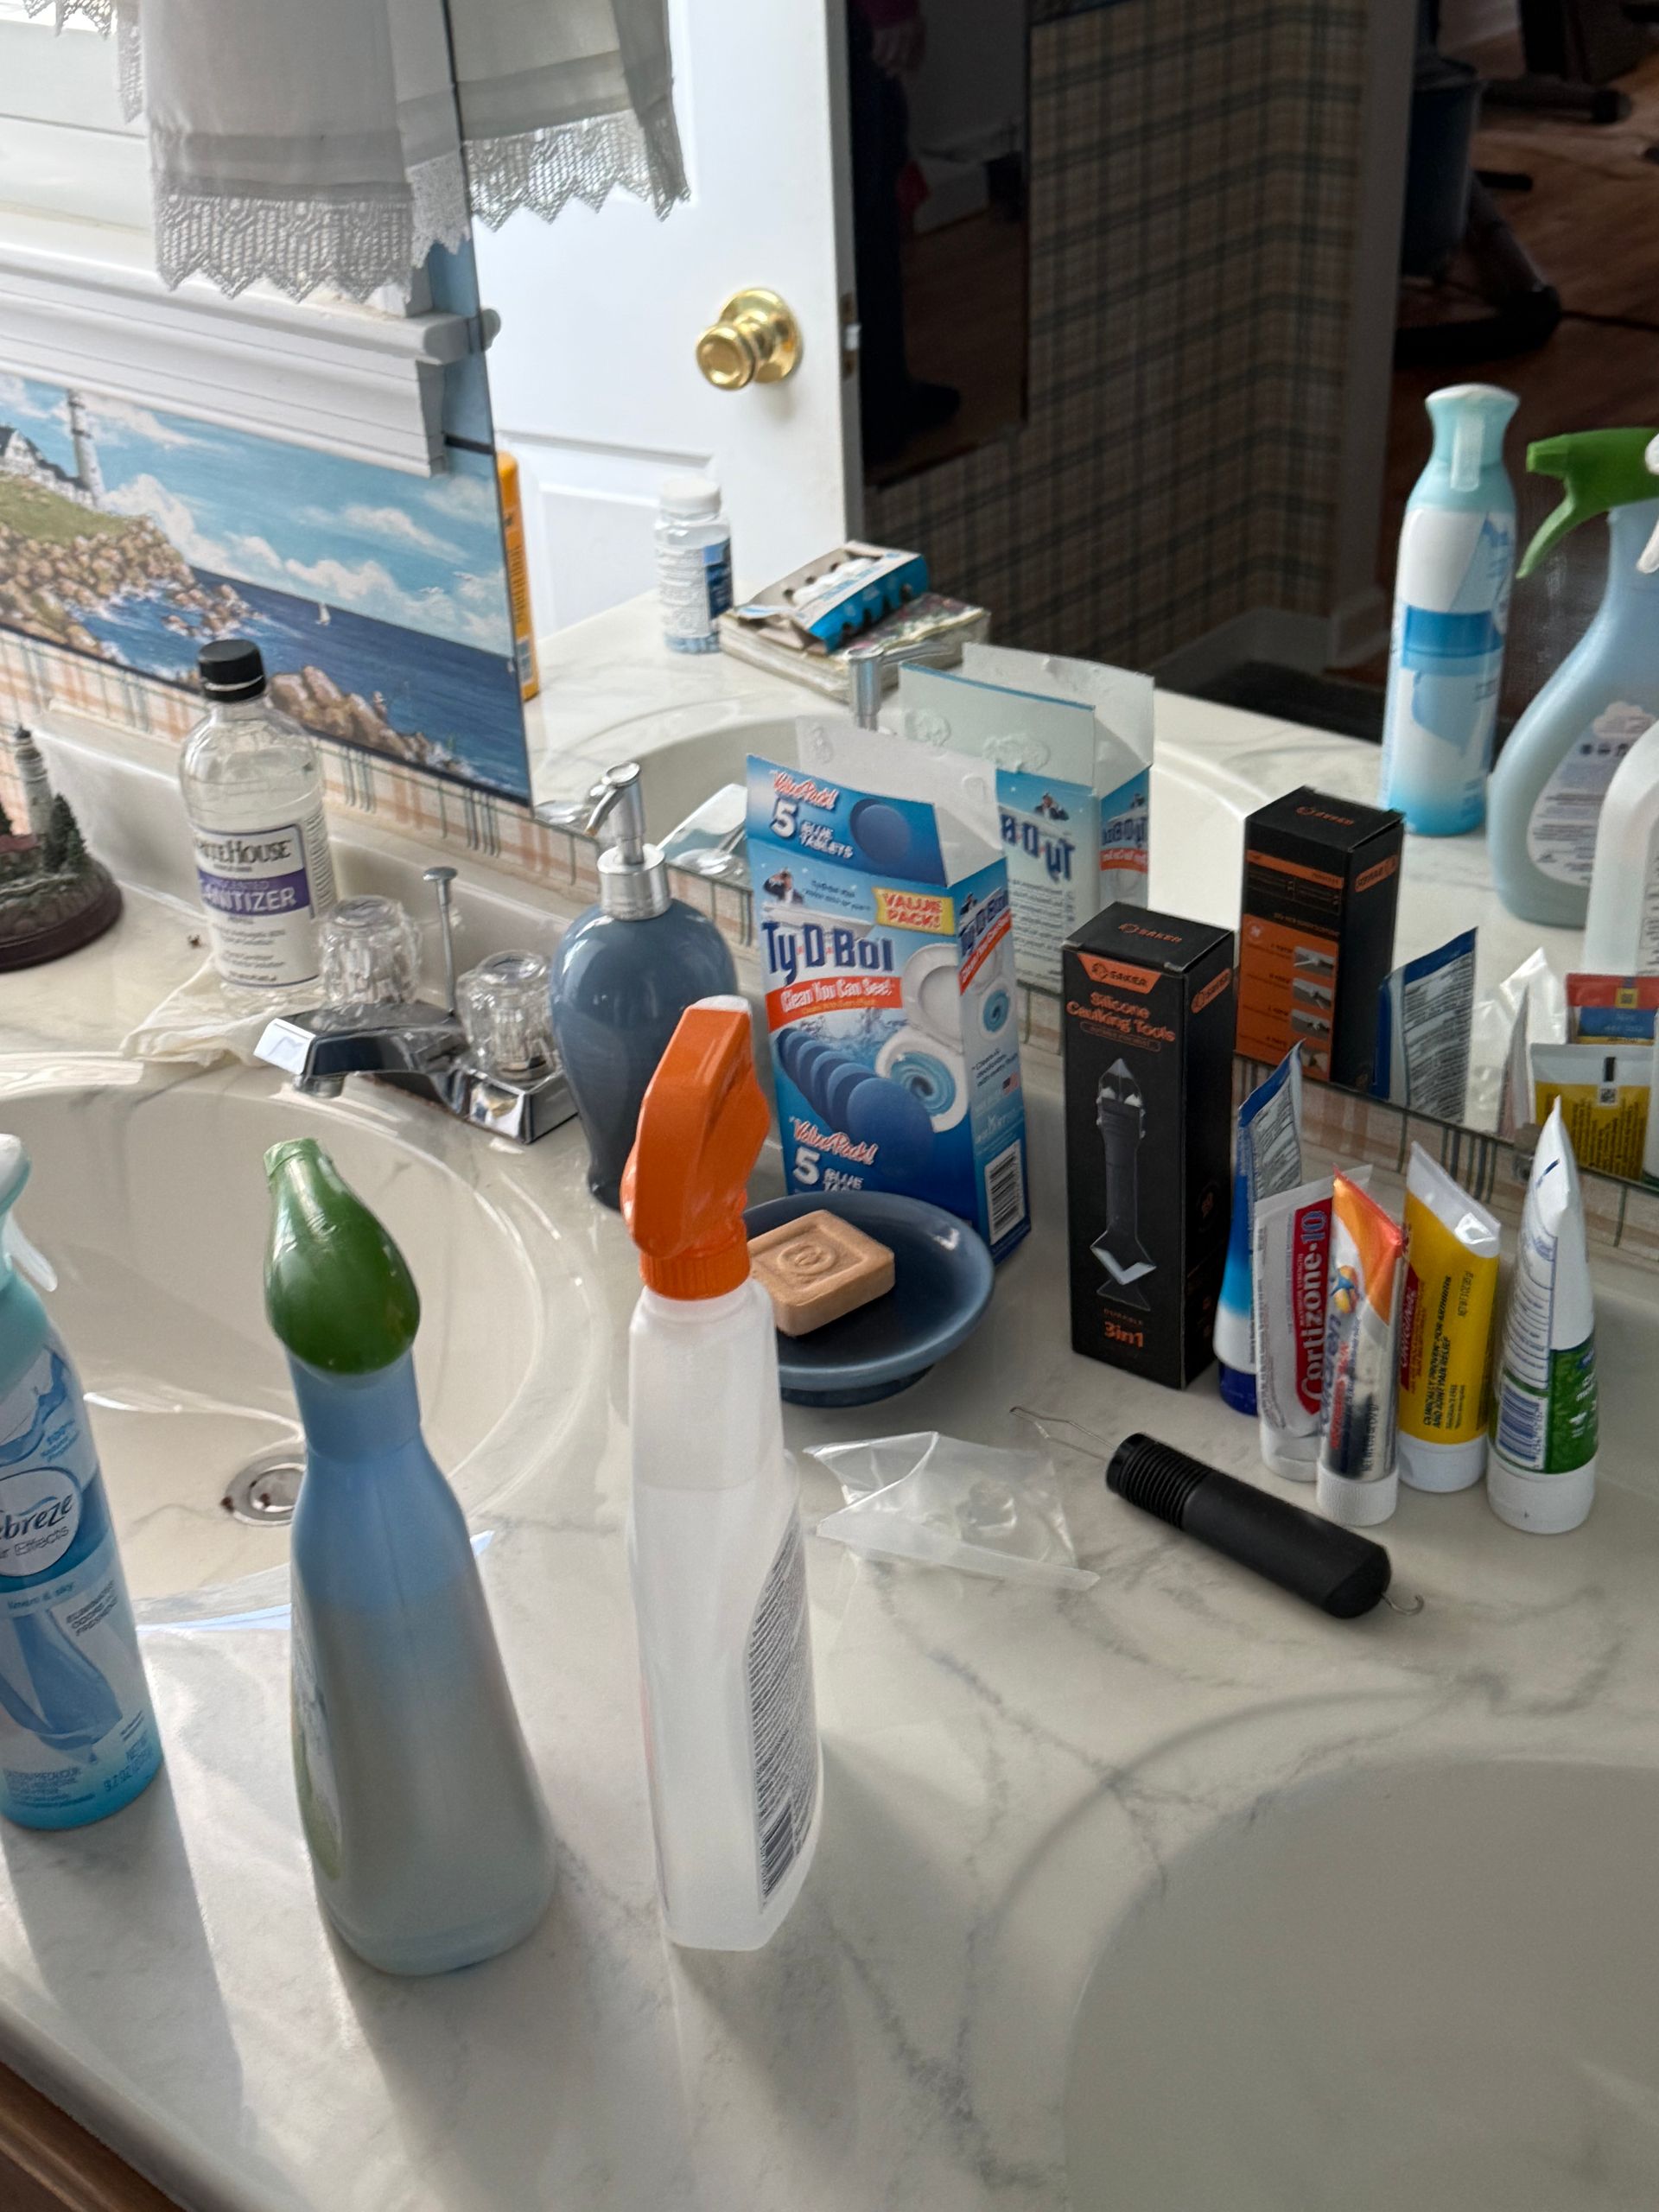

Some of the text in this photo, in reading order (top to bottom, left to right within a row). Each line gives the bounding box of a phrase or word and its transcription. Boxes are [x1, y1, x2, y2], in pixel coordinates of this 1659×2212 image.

[771, 798, 797, 838] 5
[884, 893, 943, 912] VALUE
[1110, 970, 1147, 987] SAKER
[780, 988, 812, 1013] Clean
[811, 982, 836, 1002] You
[836, 979, 861, 1000] Can
[1090, 991, 1150, 1019] Silicone
[1065, 1001, 1133, 1033] Caulking
[1134, 1019, 1176, 1042] Tools
[793, 1147, 820, 1185] 5
[1104, 1321, 1144, 1348] 3in1
[15, 1526, 70, 1556] Effects
